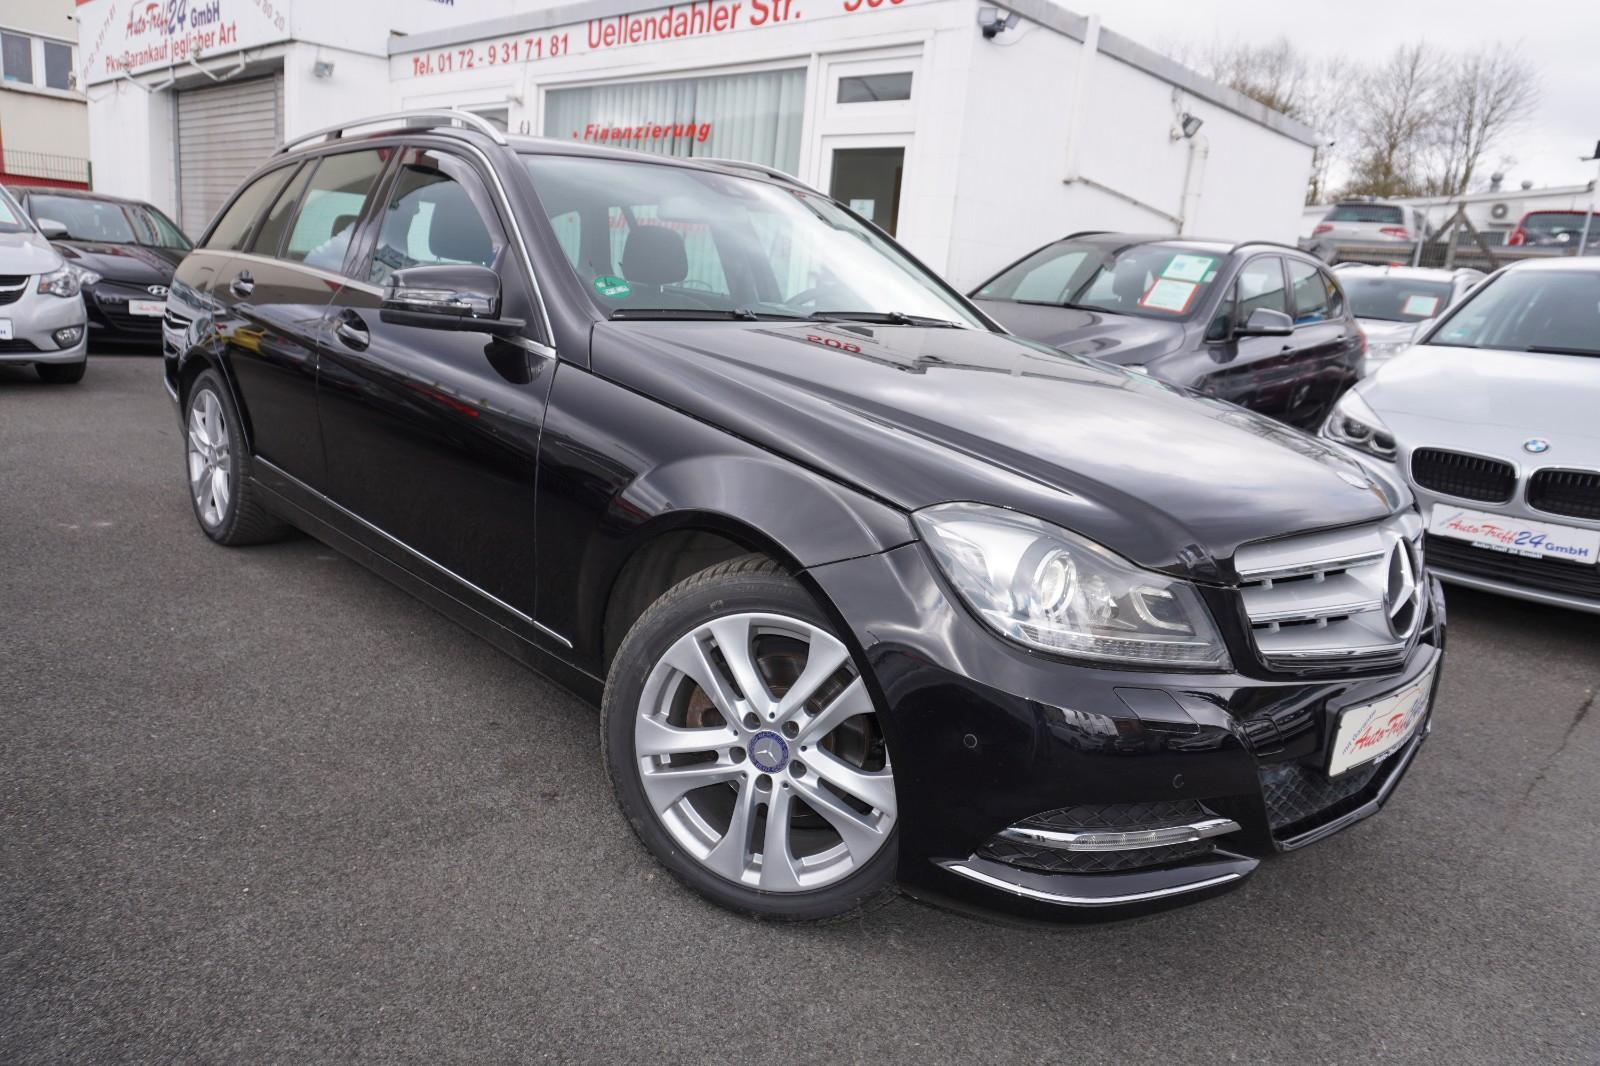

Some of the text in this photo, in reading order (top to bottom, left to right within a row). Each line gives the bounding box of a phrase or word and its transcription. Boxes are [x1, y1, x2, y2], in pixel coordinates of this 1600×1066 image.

[191, 0, 220, 28] GmbH
[587, 2, 743, 49] Uellendahler
[219, 20, 237, 46] Art
[412, 54, 434, 76] Tel.
[438, 53, 452, 73] 01
[458, 48, 474, 69] 72
[488, 45, 497, 65] 9
[501, 39, 518, 64] 31
[525, 37, 542, 60] 71
[549, 33, 568, 56] 81
[584, 121, 711, 143] Finanzierung
[1545, 542, 1589, 557] GmbH
